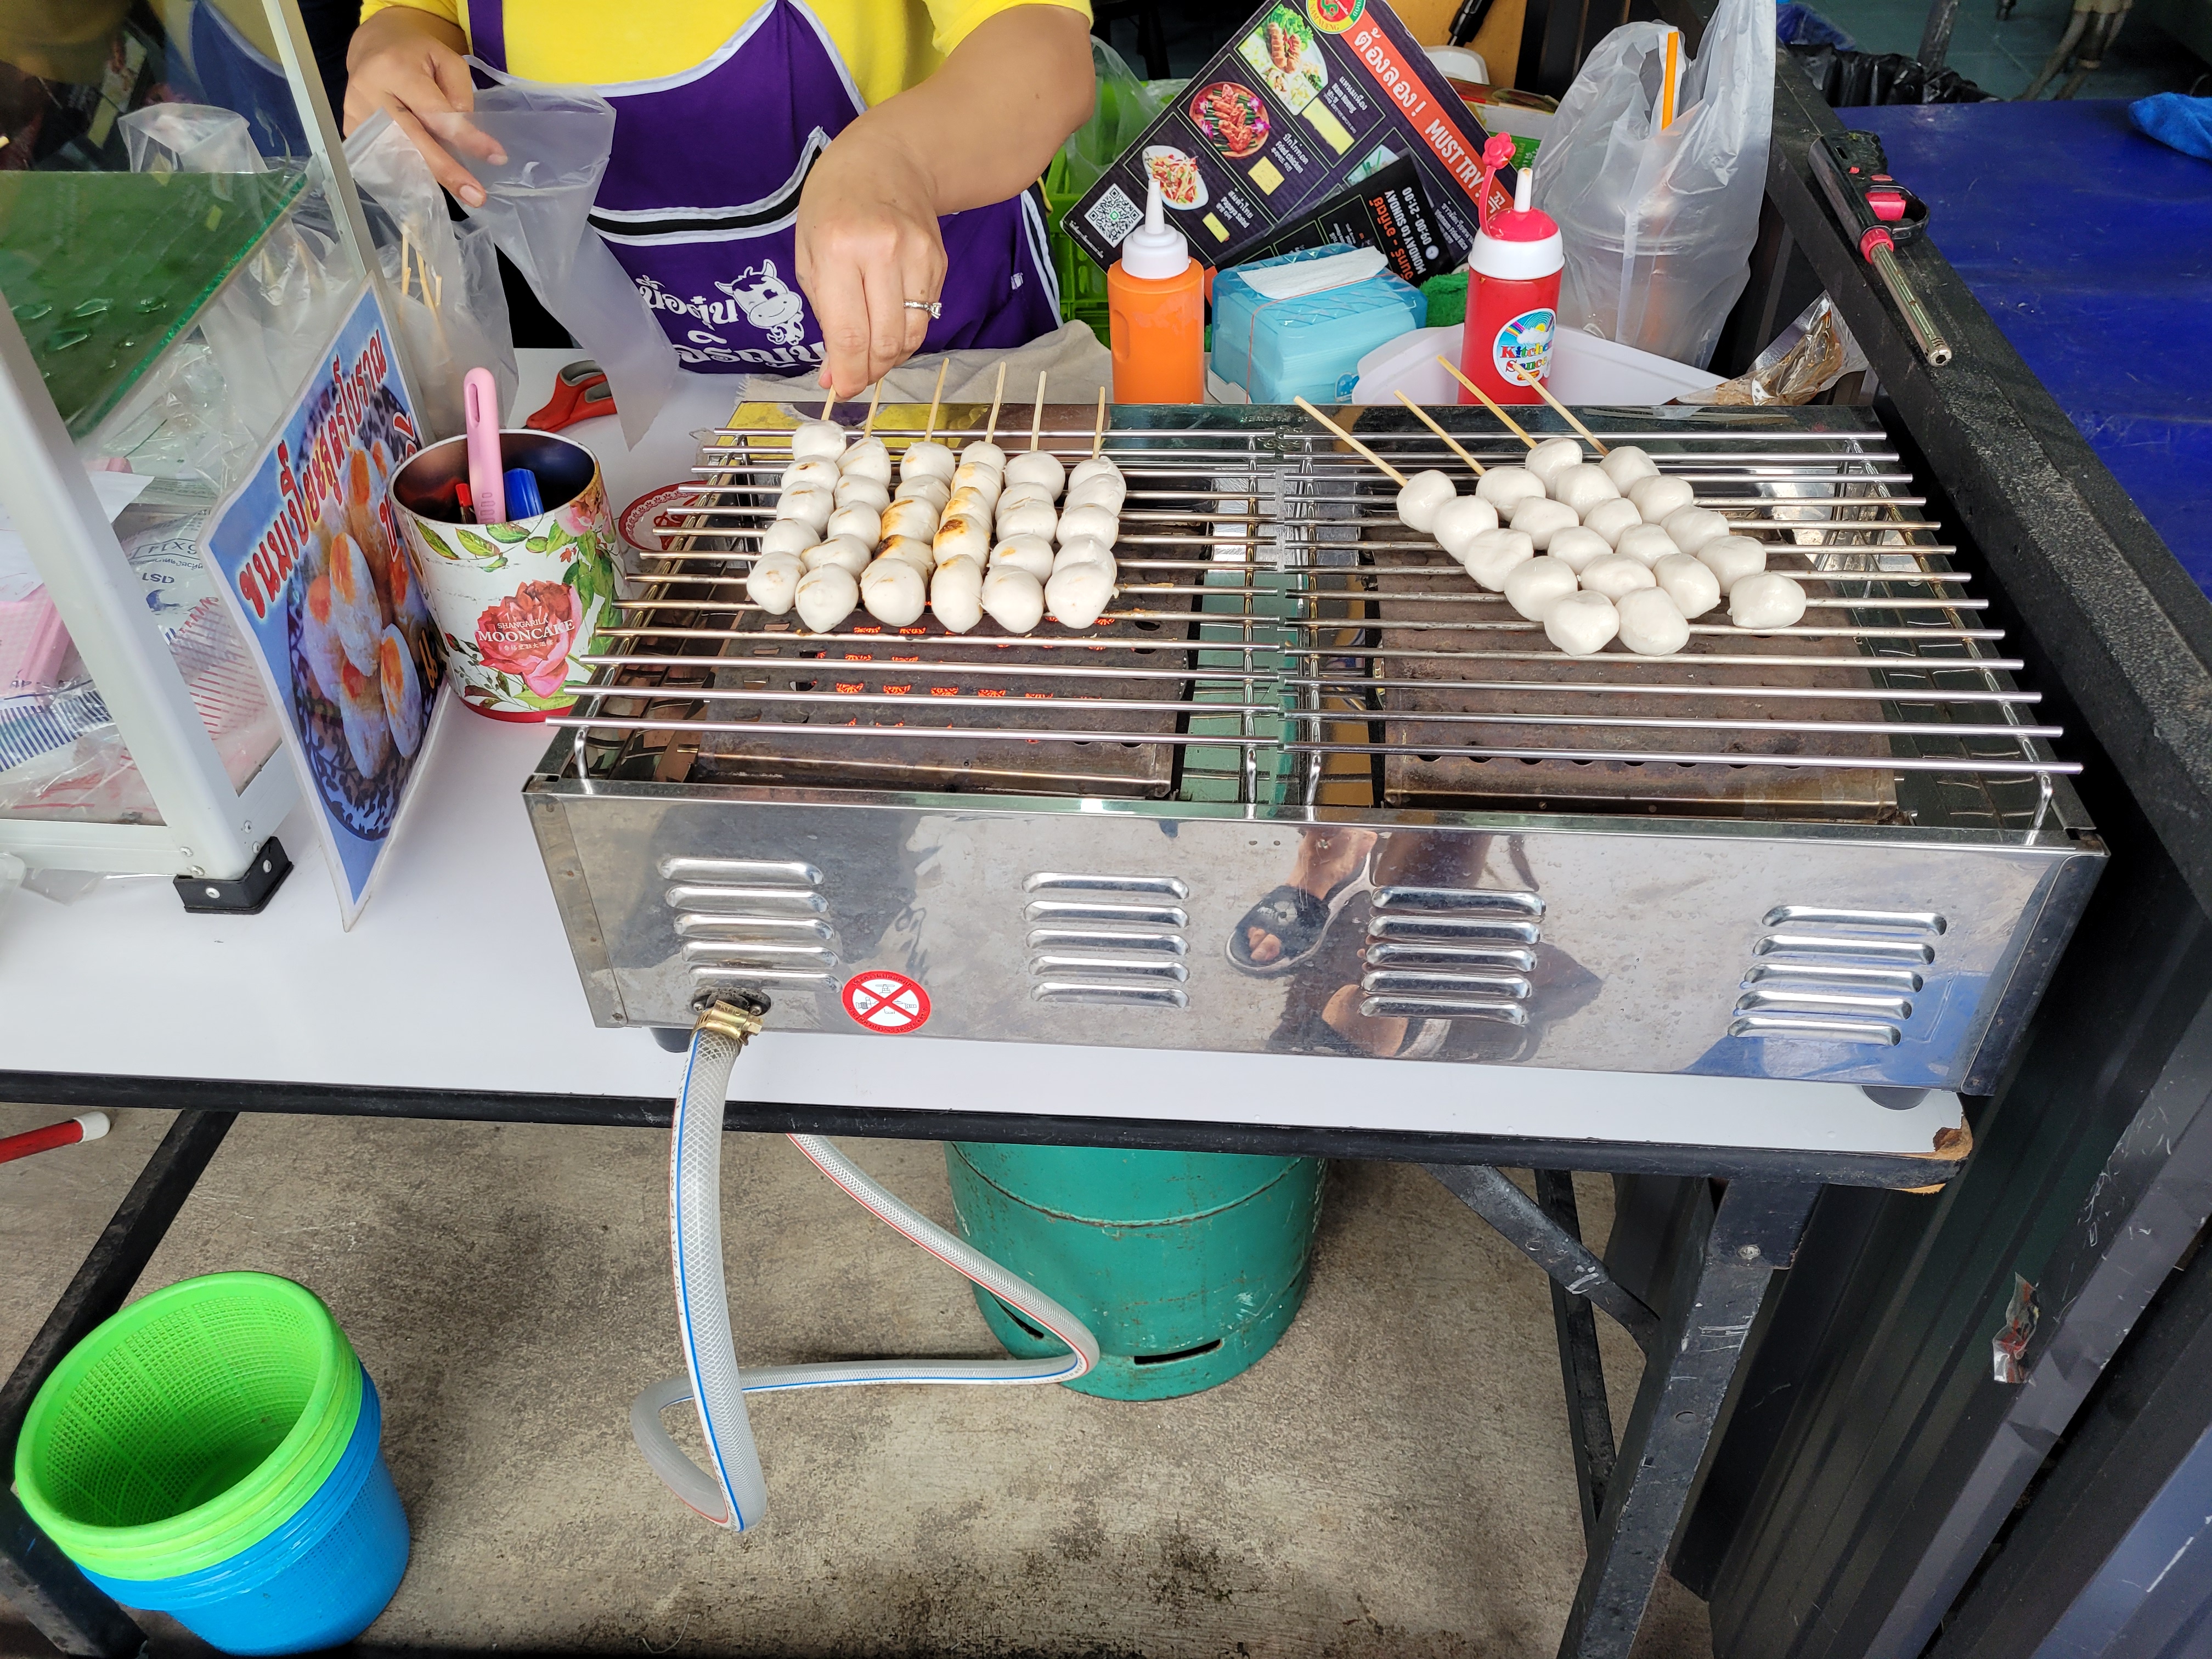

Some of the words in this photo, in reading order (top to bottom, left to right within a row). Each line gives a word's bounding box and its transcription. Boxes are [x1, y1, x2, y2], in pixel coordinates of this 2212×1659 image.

[1310, 4, 1318, 20] NAM
[1317, 18, 1339, 30] NUENG
[1330, 82, 1345, 98] Nam
[1340, 94, 1357, 114] Nueng
[1353, 28, 1417, 108] ต้องลอง
[1424, 119, 1465, 165] MUST
[1454, 155, 1485, 190] TRY
[1274, 140, 1290, 156] Fried
[1285, 152, 1304, 173] chicken
[1220, 196, 1238, 216] Papaya
[1234, 212, 1250, 228] Salad
[1227, 187, 1254, 219] ส้มตำไทย
[1368, 196, 1396, 237] อาทิตย์
[1384, 189, 1407, 228] SUNDAY
[1402, 187, 1418, 215] 21:00
[1401, 225, 1412, 237] to
[1414, 218, 1432, 245] 09:00
[1434, 208, 1452, 230] Vietnam
[1448, 227, 1461, 241] Fried
[1457, 238, 1469, 251] Rice
[1404, 236, 1427, 275] MONDAY
[635, 274, 740, 331] นื้อตุ๋น
[1505, 356, 1549, 373] Sauce
[478, 619, 575, 642] MOONCAKE
[496, 617, 549, 629] SHANGARILA
